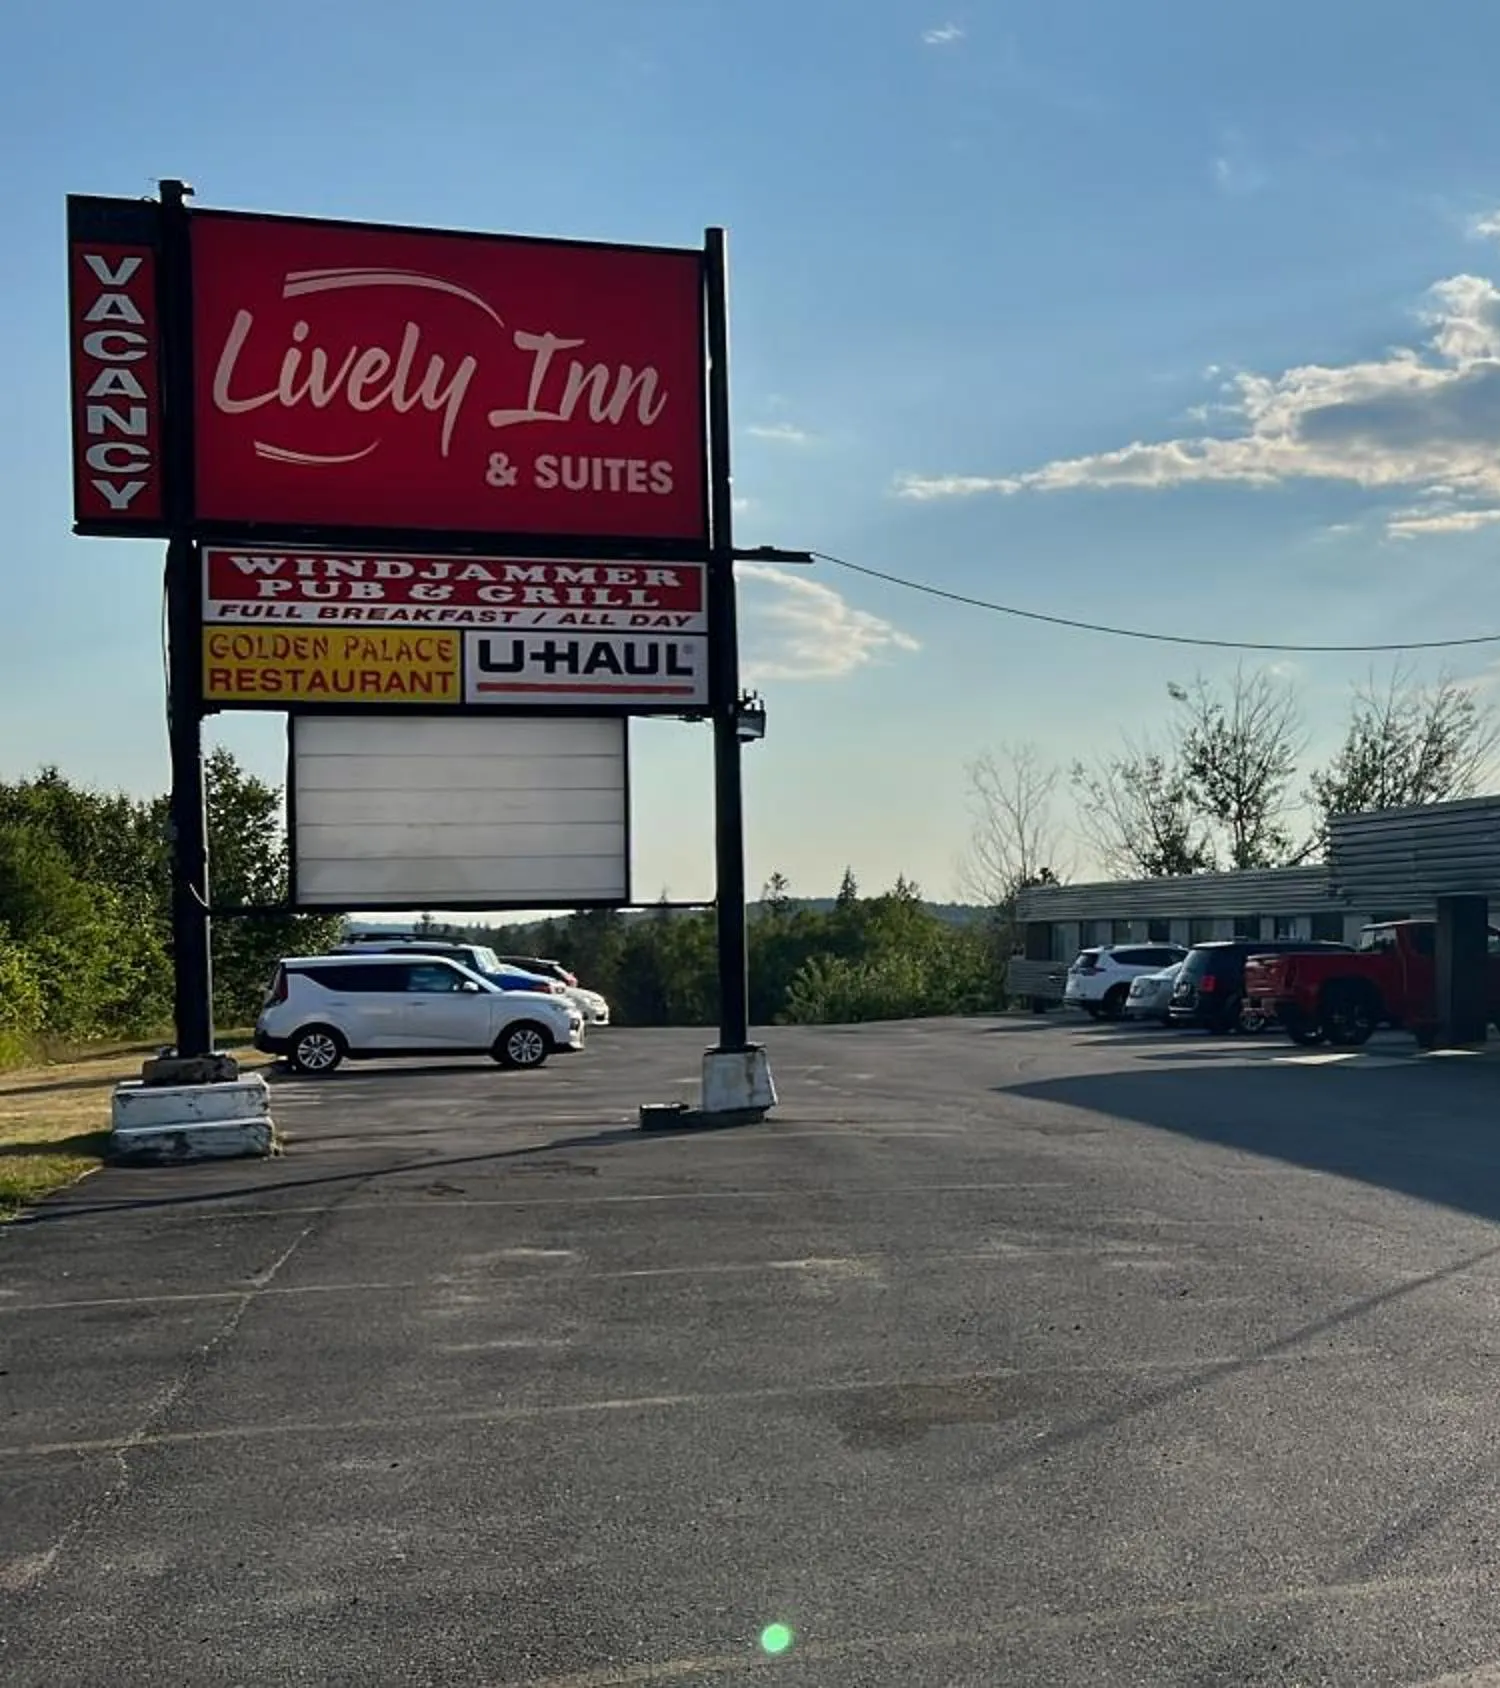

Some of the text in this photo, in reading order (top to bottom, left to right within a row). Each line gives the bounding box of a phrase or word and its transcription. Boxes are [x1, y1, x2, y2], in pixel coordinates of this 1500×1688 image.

[81, 253, 152, 512] VACANCY
[213, 309, 668, 457] Lively Inn
[485, 451, 675, 495] & SUITES
[228, 556, 680, 587] WINDJAMMER
[257, 579, 660, 607] PUB & GRILL
[218, 604, 302, 618] FULL
[317, 606, 515, 624] BREAKFAST
[557, 612, 617, 626] ALL
[628, 615, 694, 628] DAY
[208, 633, 454, 662] GOLDEN PALACE
[209, 668, 455, 694] RESTAURANT
